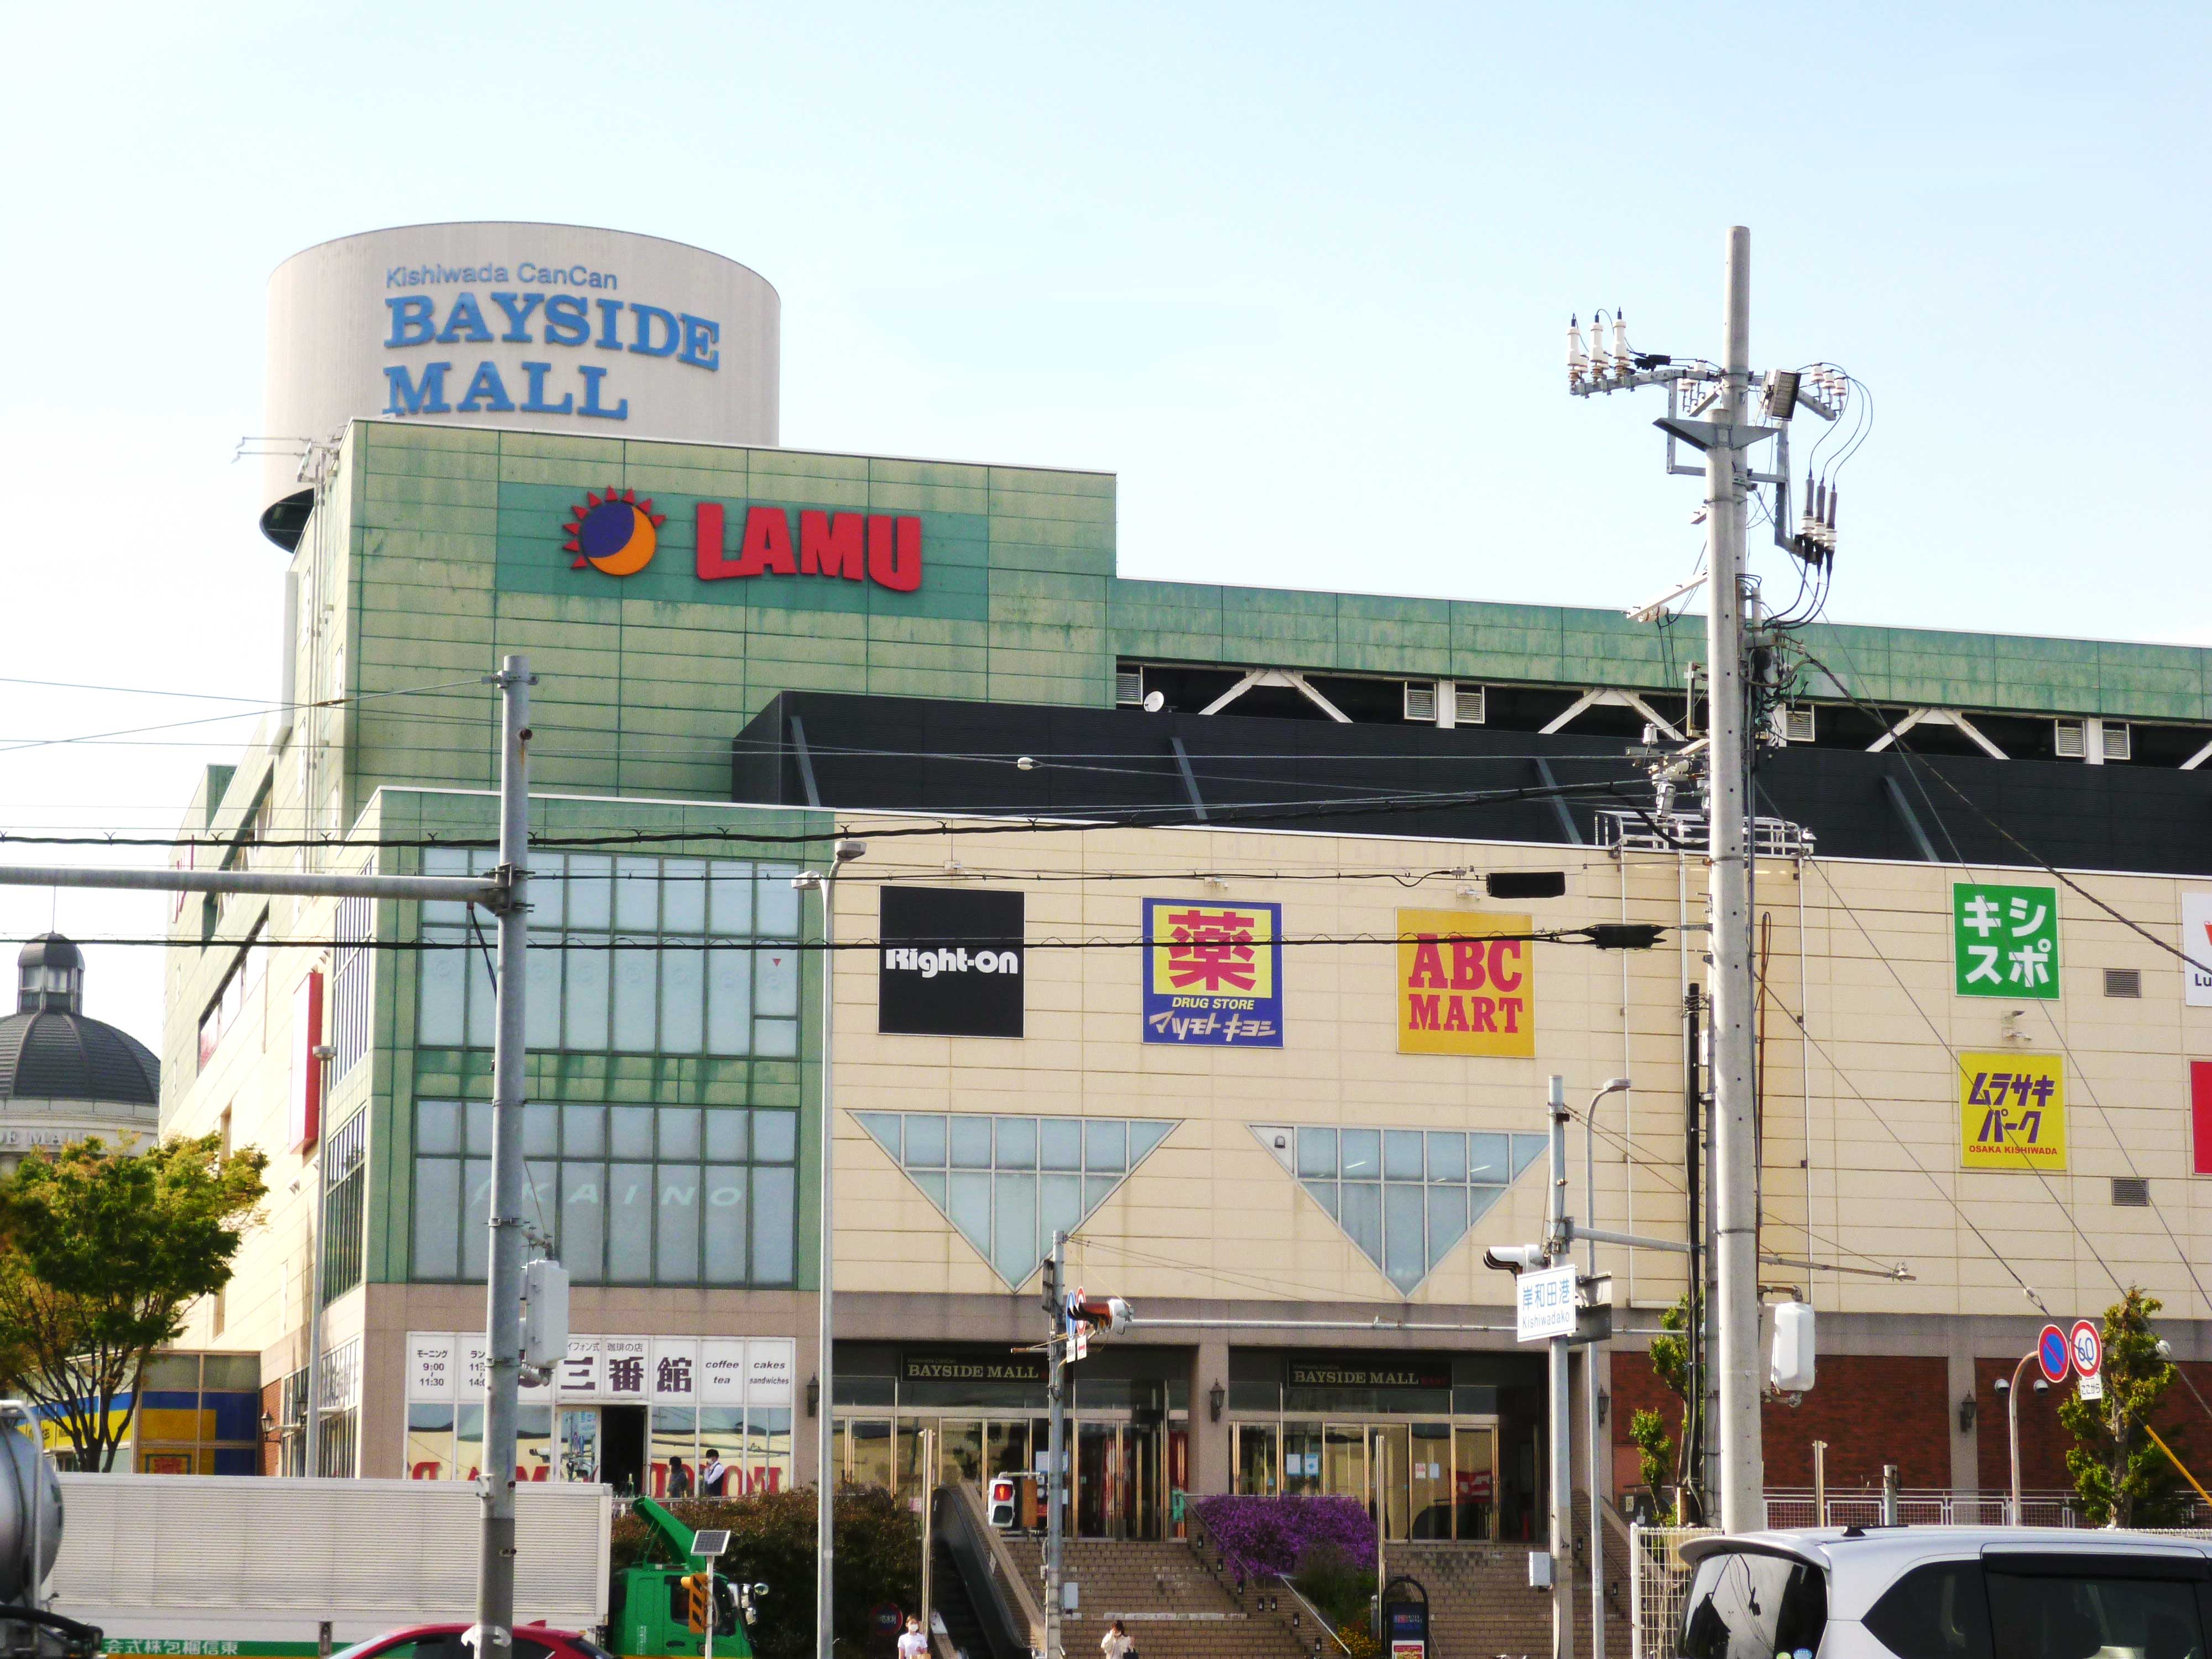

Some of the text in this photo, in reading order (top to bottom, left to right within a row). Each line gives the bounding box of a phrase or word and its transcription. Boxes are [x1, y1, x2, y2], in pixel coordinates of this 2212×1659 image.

[387, 262, 618, 290] Kishiwada CanCan
[383, 291, 721, 372] BAYSIDE
[382, 361, 629, 420] MALL
[696, 502, 921, 592] LAMU
[1963, 895, 2047, 937] キシ
[1168, 909, 1257, 992] 薬
[885, 948, 1019, 978] Right-on
[1408, 933, 1522, 993] ABC
[1964, 938, 2052, 988] スポ
[1172, 997, 1255, 1010] DRUG STORE
[1408, 993, 1524, 1034] MART
[1968, 1072, 2056, 1107] ムラサキ
[1977, 1108, 2042, 1144] パーク
[1969, 1145, 2058, 1155] OSAKA KISHIWADA
[469, 1177, 743, 1209] KAINO
[1523, 1278, 1569, 1310] 岸和田港
[1522, 1310, 1569, 1329] Kishiwadako
[417, 1350, 448, 1358] モーニング
[470, 1350, 485, 1359] ラン
[567, 1342, 643, 1352] イフォン式 珈琲の店
[2078, 1337, 2094, 1361] 60
[422, 1363, 445, 1371] 9:00
[705, 1360, 739, 1369] coffee
[753, 1361, 786, 1369] cakes
[907, 1364, 1039, 1379] BAYSIDE MALL
[419, 1378, 444, 1386] 11:30
[749, 1376, 790, 1385] sandwiches
[1293, 1370, 1366, 1383] BAYSIDE
[1369, 1371, 1419, 1384] MALL
[2081, 1383, 2101, 1395] ここから
